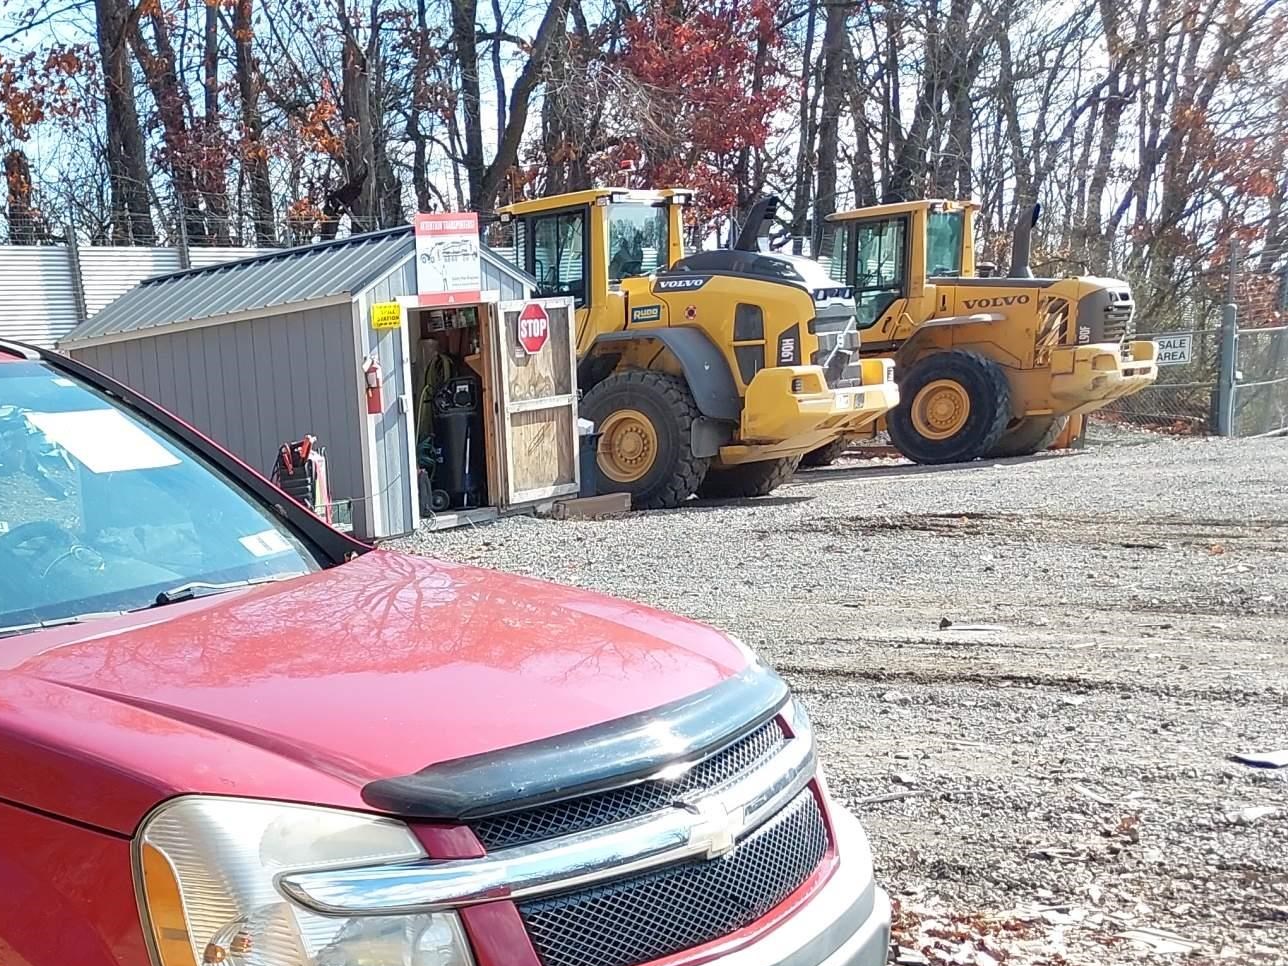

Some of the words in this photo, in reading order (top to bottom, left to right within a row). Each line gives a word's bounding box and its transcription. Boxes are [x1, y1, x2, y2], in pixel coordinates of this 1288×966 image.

[659, 279, 704, 289] VOLVO
[961, 294, 1030, 309] VOLVO
[520, 319, 547, 338] STOP
[781, 338, 795, 362] L90H
[1158, 339, 1187, 350] SALE
[1156, 351, 1186, 362] AREA
